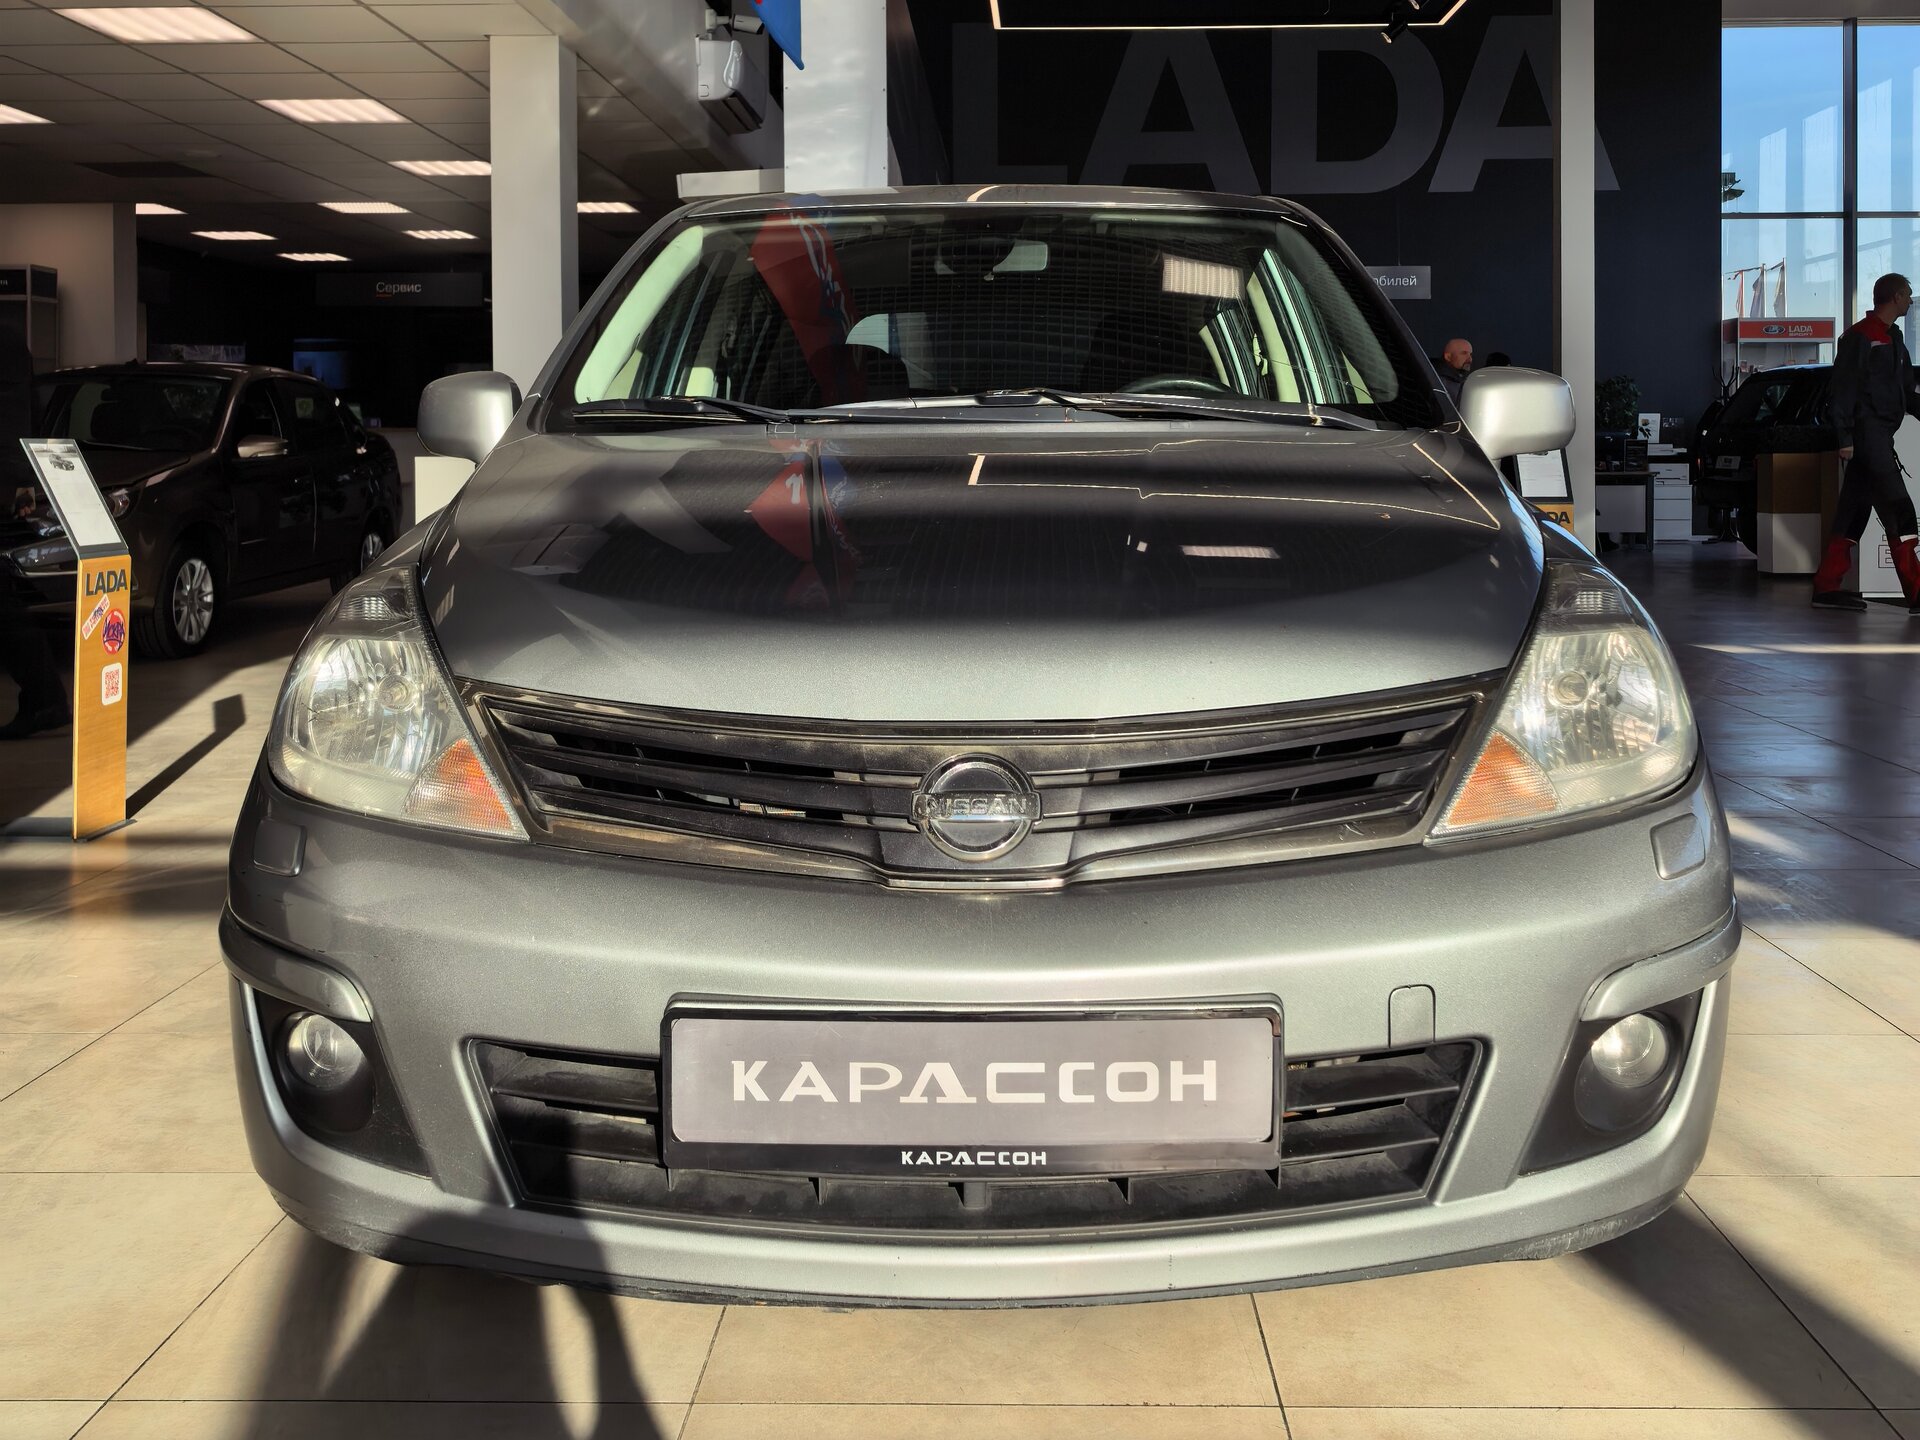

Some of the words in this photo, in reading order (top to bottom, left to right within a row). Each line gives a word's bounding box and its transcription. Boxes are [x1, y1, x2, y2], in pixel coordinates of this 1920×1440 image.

[951, 14, 1621, 194] LADA
[376, 281, 421, 294] Сервис
[1788, 325, 1813, 333] LADA
[85, 568, 128, 596] LADA
[926, 796, 1027, 817] NISSAN
[731, 1059, 1217, 1104] КАРАССОН
